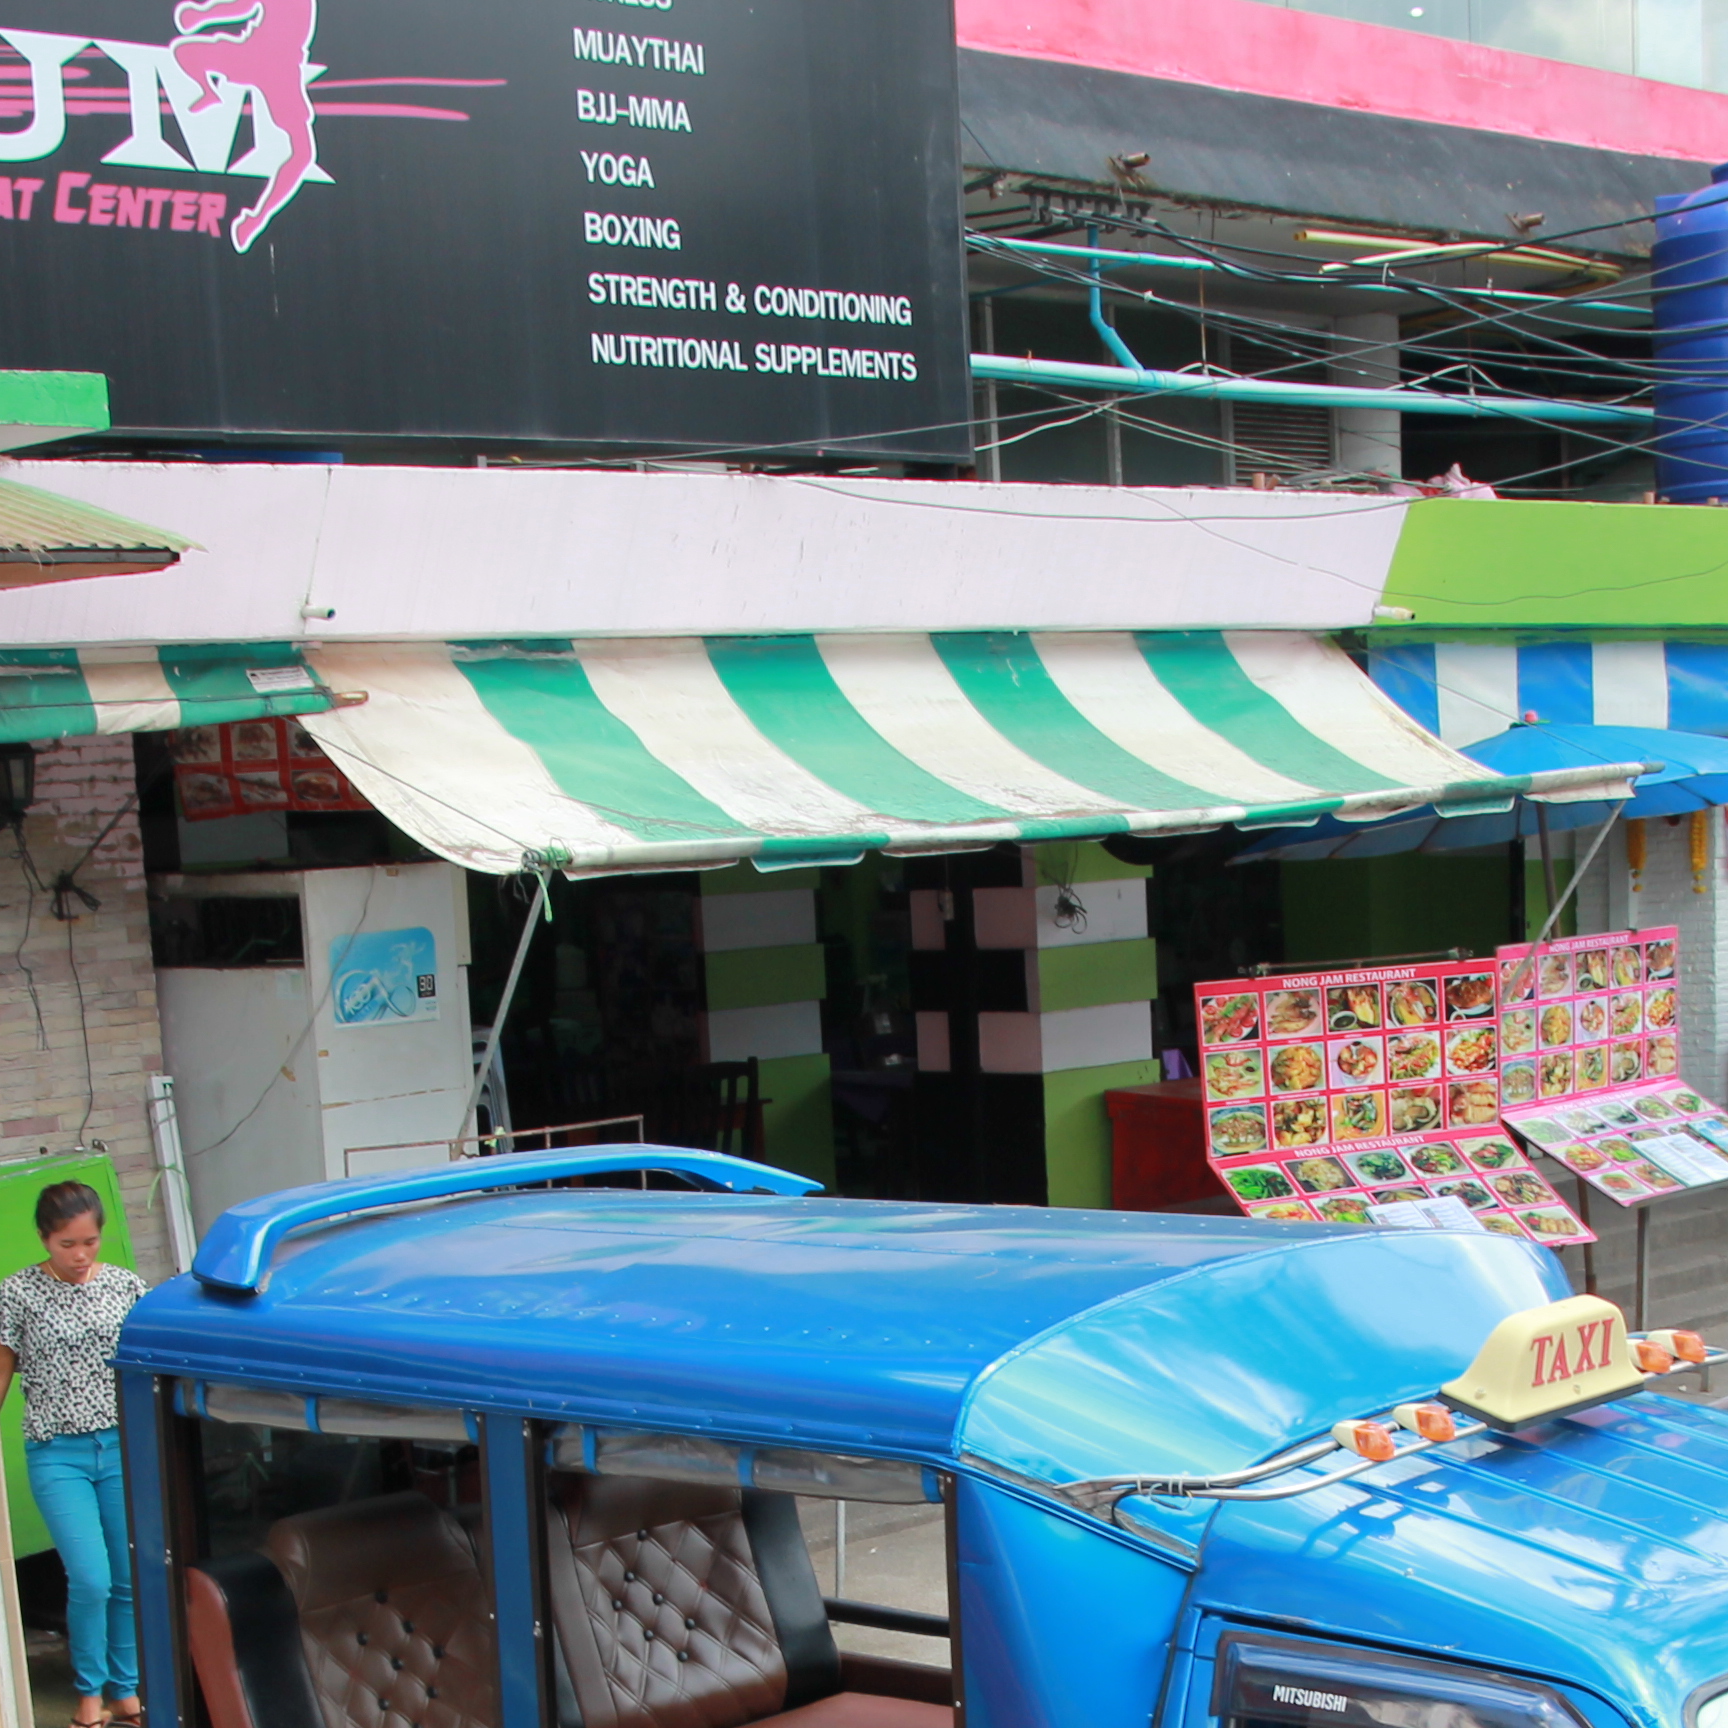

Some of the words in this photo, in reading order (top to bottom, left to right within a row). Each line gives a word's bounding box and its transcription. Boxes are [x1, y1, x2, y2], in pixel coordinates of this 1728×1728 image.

[573, 27, 705, 75] MUAYTHAI
[577, 89, 692, 134] BJJ-MMA
[580, 151, 655, 189] YOGA
[584, 212, 682, 251] BOXING
[588, 273, 716, 312] STRENGTH
[725, 283, 747, 314] &
[754, 285, 913, 327] CONDITIONING
[590, 333, 748, 373] NUTRITIONAL
[754, 341, 918, 382] SUPPLEMENTS
[1282, 976, 1319, 989] NONG
[1320, 974, 1344, 986] JAM
[1345, 968, 1416, 983] RESTAURANT
[1294, 1147, 1330, 1158] NONG
[1331, 1144, 1354, 1154] JAM
[1356, 1135, 1425, 1150] RESTAURANT
[1531, 1317, 1615, 1387] TAXI
[1273, 1684, 1347, 1712] MITSUBISHI
